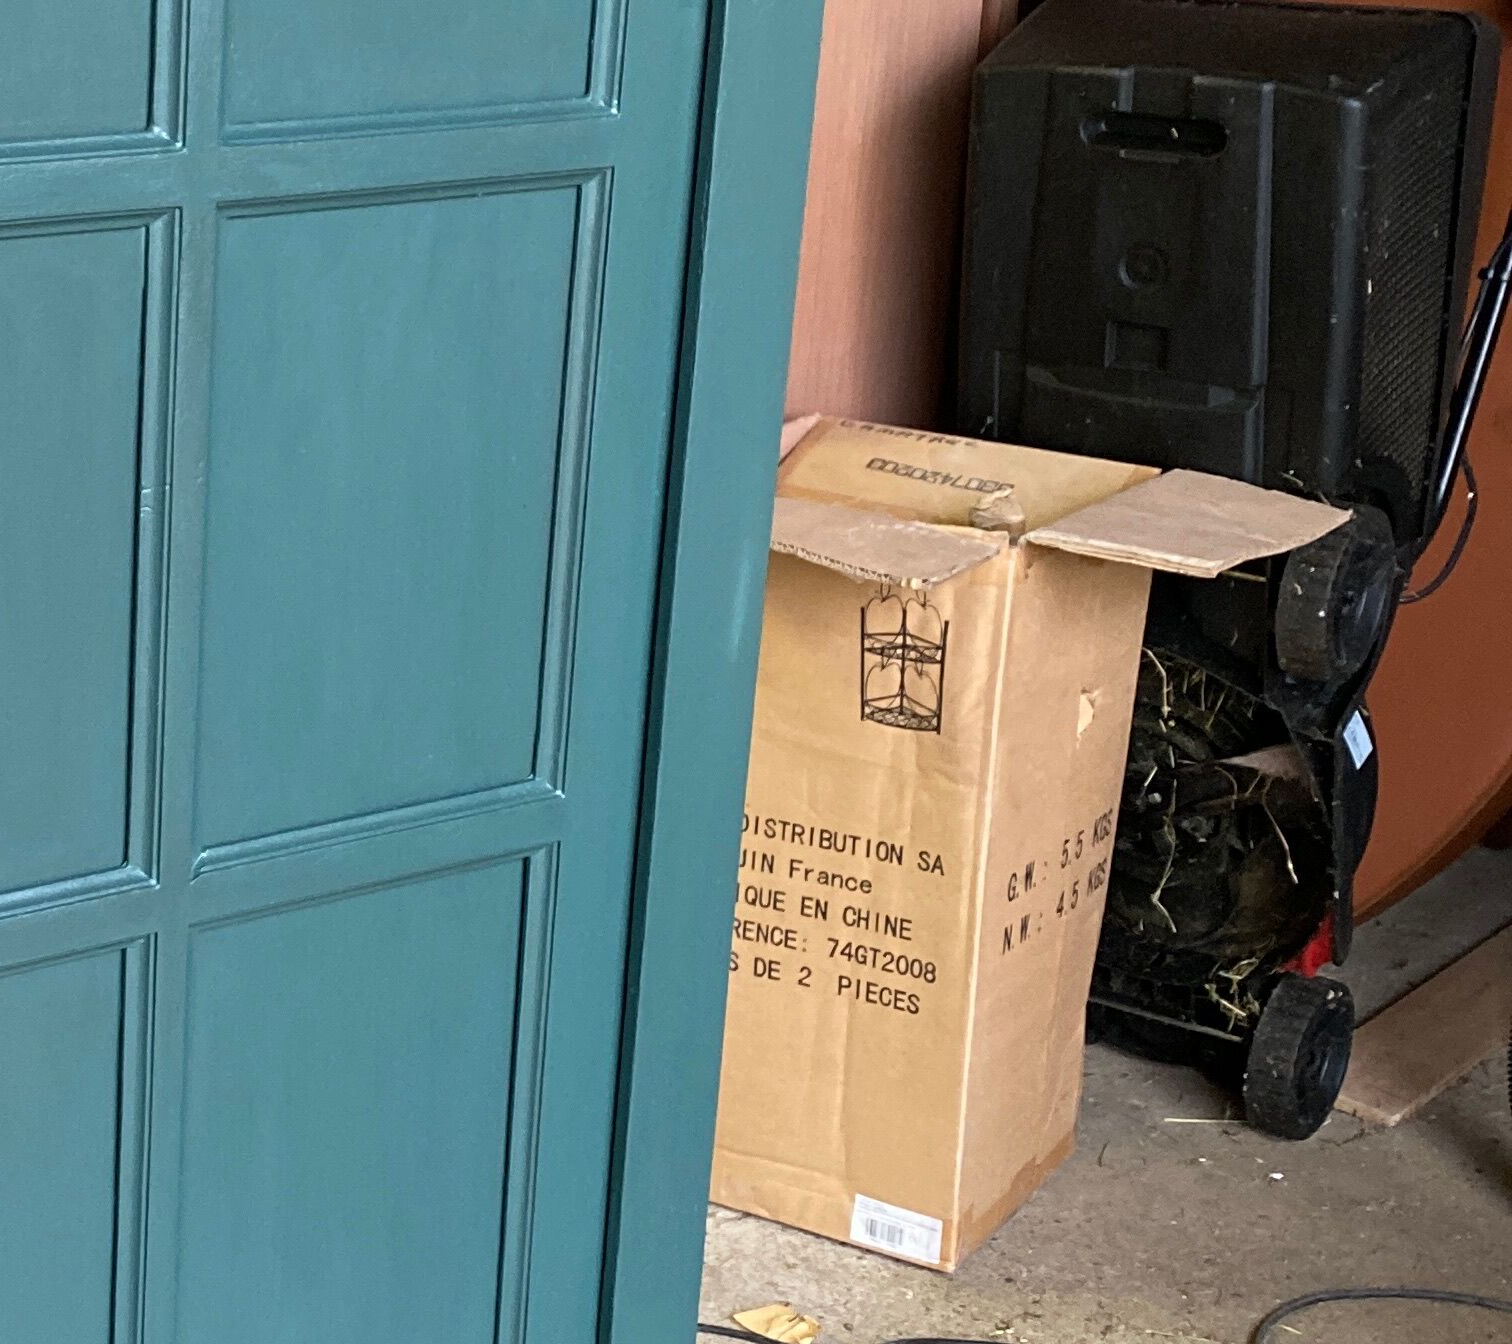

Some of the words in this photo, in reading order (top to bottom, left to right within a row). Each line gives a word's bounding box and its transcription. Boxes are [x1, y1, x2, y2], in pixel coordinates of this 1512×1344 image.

[1061, 829, 1084, 869] 5.5
[1092, 808, 1113, 847] KGS
[789, 858, 873, 894] France
[917, 851, 945, 876] SA
[1056, 879, 1080, 918] 4.5
[1087, 857, 1107, 897] KGS
[800, 896, 828, 921] EN
[842, 905, 913, 941] CHINE
[827, 937, 937, 984] 74GT2008
[753, 957, 781, 981] DE
[798, 966, 812, 987] 2
[838, 975, 920, 1015] PIECES
